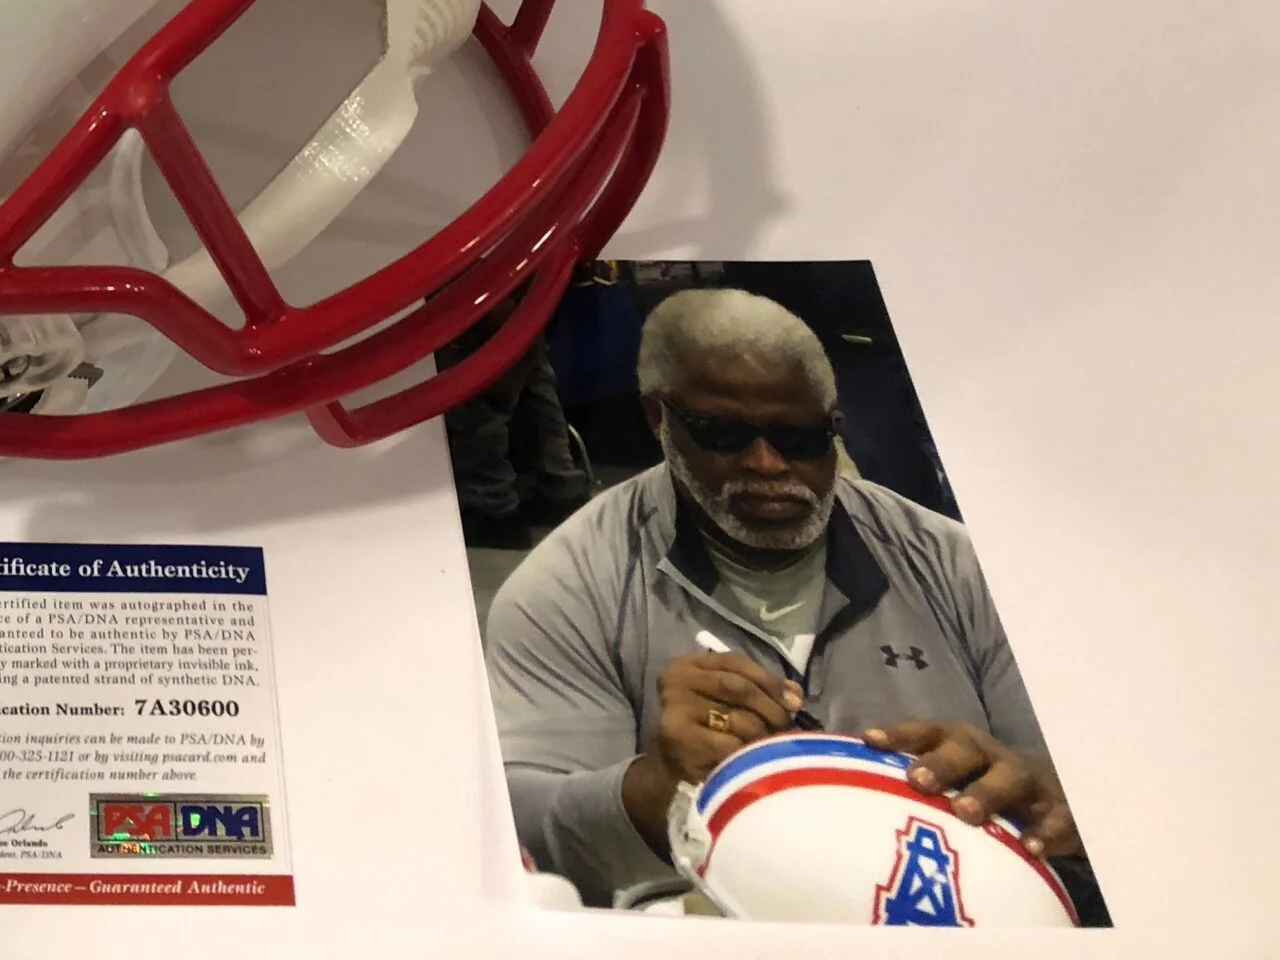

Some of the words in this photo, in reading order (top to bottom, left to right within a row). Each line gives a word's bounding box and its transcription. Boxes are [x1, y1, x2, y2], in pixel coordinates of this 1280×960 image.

[78, 558, 103, 577] of
[107, 560, 250, 582] Authenticity
[53, 598, 83, 611] item
[89, 601, 115, 611] was
[120, 599, 207, 613] autographed
[212, 601, 226, 612] in
[232, 601, 254, 612] the
[17, 612, 33, 624] of
[35, 615, 42, 624] a
[48, 613, 119, 625] PSA/DNA
[124, 615, 224, 627] representative
[230, 616, 255, 627] and
[51, 629, 64, 639] to
[69, 628, 84, 639] be
[90, 628, 157, 641] authentic
[162, 629, 178, 642] by
[184, 629, 256, 641] PSA/DNA
[110, 644, 135, 654] The
[140, 644, 168, 655] item
[172, 644, 194, 656] has
[198, 645, 228, 656] been
[232, 647, 258, 659] per-
[11, 658, 58, 669] marked
[62, 658, 91, 669] with
[93, 661, 101, 669] a
[104, 659, 174, 672] proprietary
[178, 659, 230, 671] invisible
[22, 676, 29, 684] a
[34, 672, 90, 687] patented
[94, 673, 136, 685] strand
[140, 673, 154, 685] of
[158, 674, 218, 688] synthetic
[56, 702, 125, 717] Number:
[134, 699, 240, 718] 7A30600
[25, 732, 81, 746] inquiries
[84, 735, 106, 745] can
[110, 734, 124, 745] be
[126, 734, 160, 746] made
[164, 734, 176, 746] to
[180, 734, 246, 746] PSA/DNA
[250, 734, 265, 749] by
[78, 753, 91, 762] or
[94, 751, 109, 765] by
[113, 751, 159, 764] visiting
[162, 751, 238, 764] psacard.com
[241, 751, 267, 763] and
[2, 768, 22, 780] the
[26, 768, 105, 781] certification
[109, 769, 159, 781] number
[102, 804, 171, 838] PSA
[181, 805, 258, 839] DNA
[11, 839, 48, 848] Orlando
[97, 844, 204, 854] AUTHENTICATION
[207, 845, 267, 856] SERVICES
[89, 879, 181, 895] Guaranteed
[188, 880, 266, 896] Authentic
